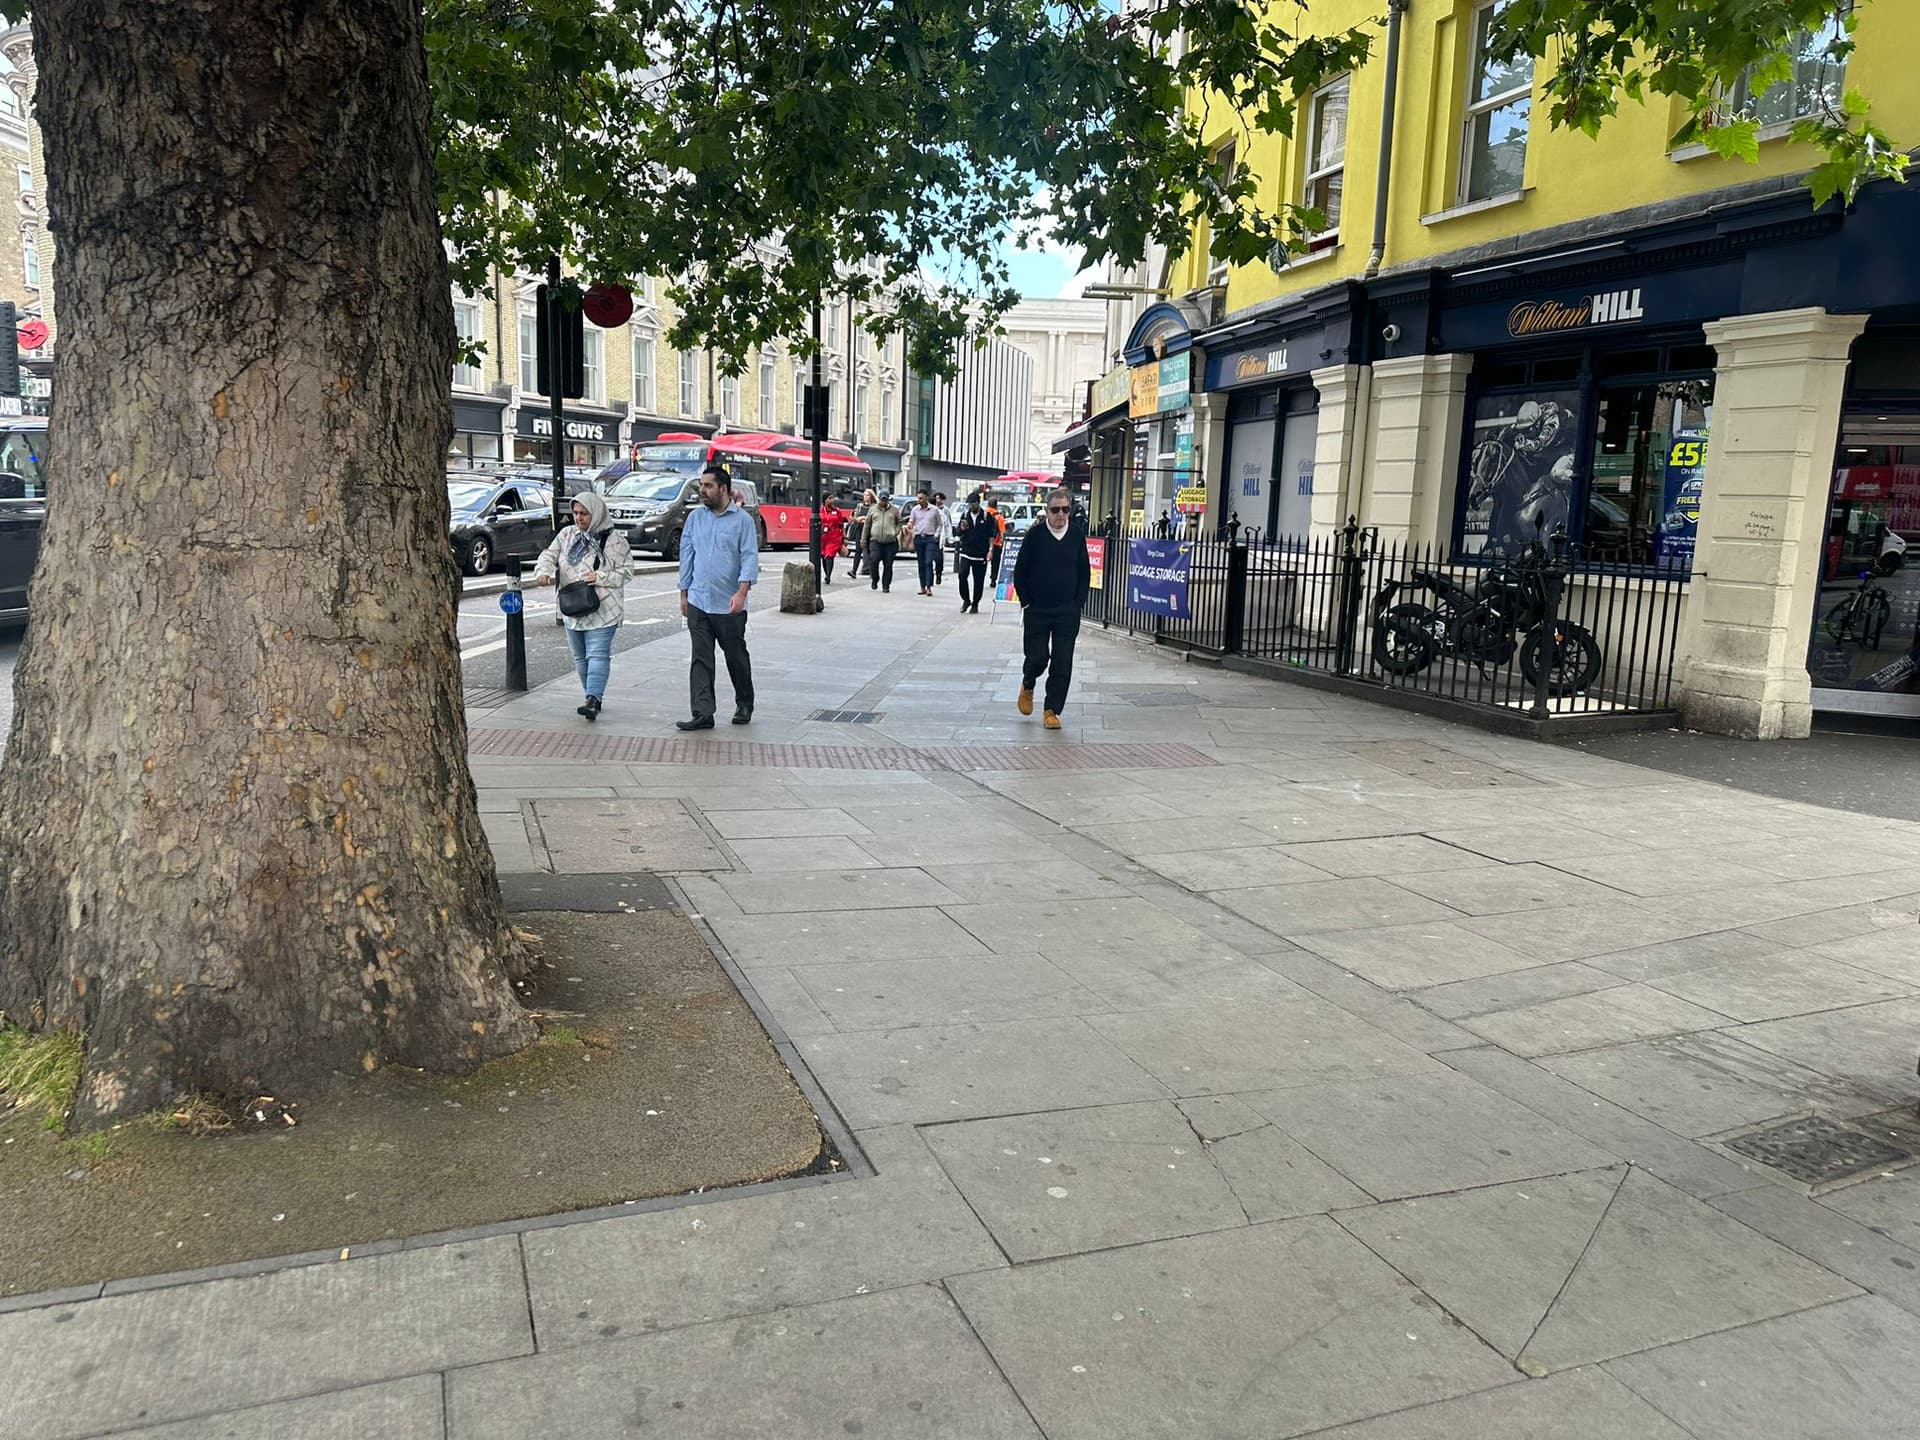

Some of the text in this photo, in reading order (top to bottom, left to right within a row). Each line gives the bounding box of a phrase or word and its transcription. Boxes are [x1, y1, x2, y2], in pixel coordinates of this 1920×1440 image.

[1507, 288, 1644, 337] William HILL
[1267, 349, 1288, 373] HILL
[566, 422, 604, 440] GUYS
[643, 447, 681, 458] Paddington
[1669, 442, 1699, 466] £5
[1243, 477, 1260, 496] HILL
[1298, 475, 1314, 496] HIL
[1676, 496, 1697, 505] FREE
[1129, 564, 1186, 583] LUGGAGE STORAGE
